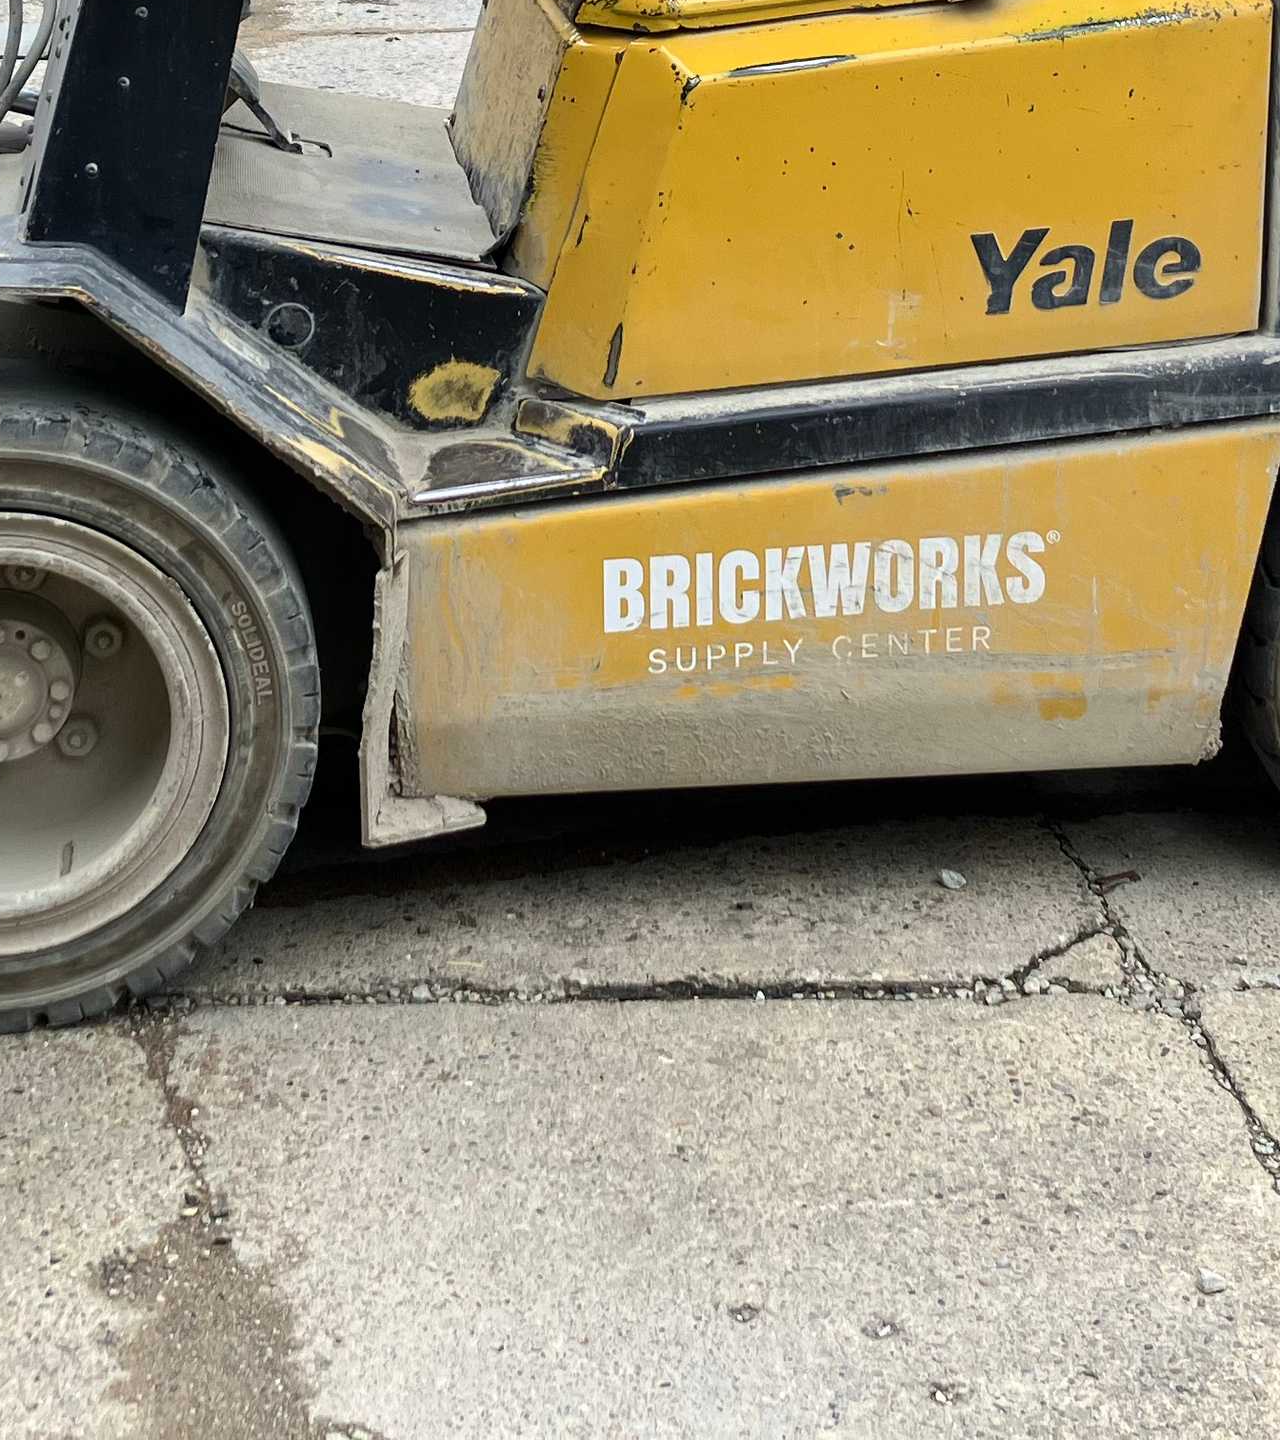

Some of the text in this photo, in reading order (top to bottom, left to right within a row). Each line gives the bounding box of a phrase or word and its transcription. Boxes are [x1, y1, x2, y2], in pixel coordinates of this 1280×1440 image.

[970, 219, 1201, 315] Yale
[231, 600, 273, 706] SOLIDEAL
[648, 625, 992, 675] SUPPLY CENTER
